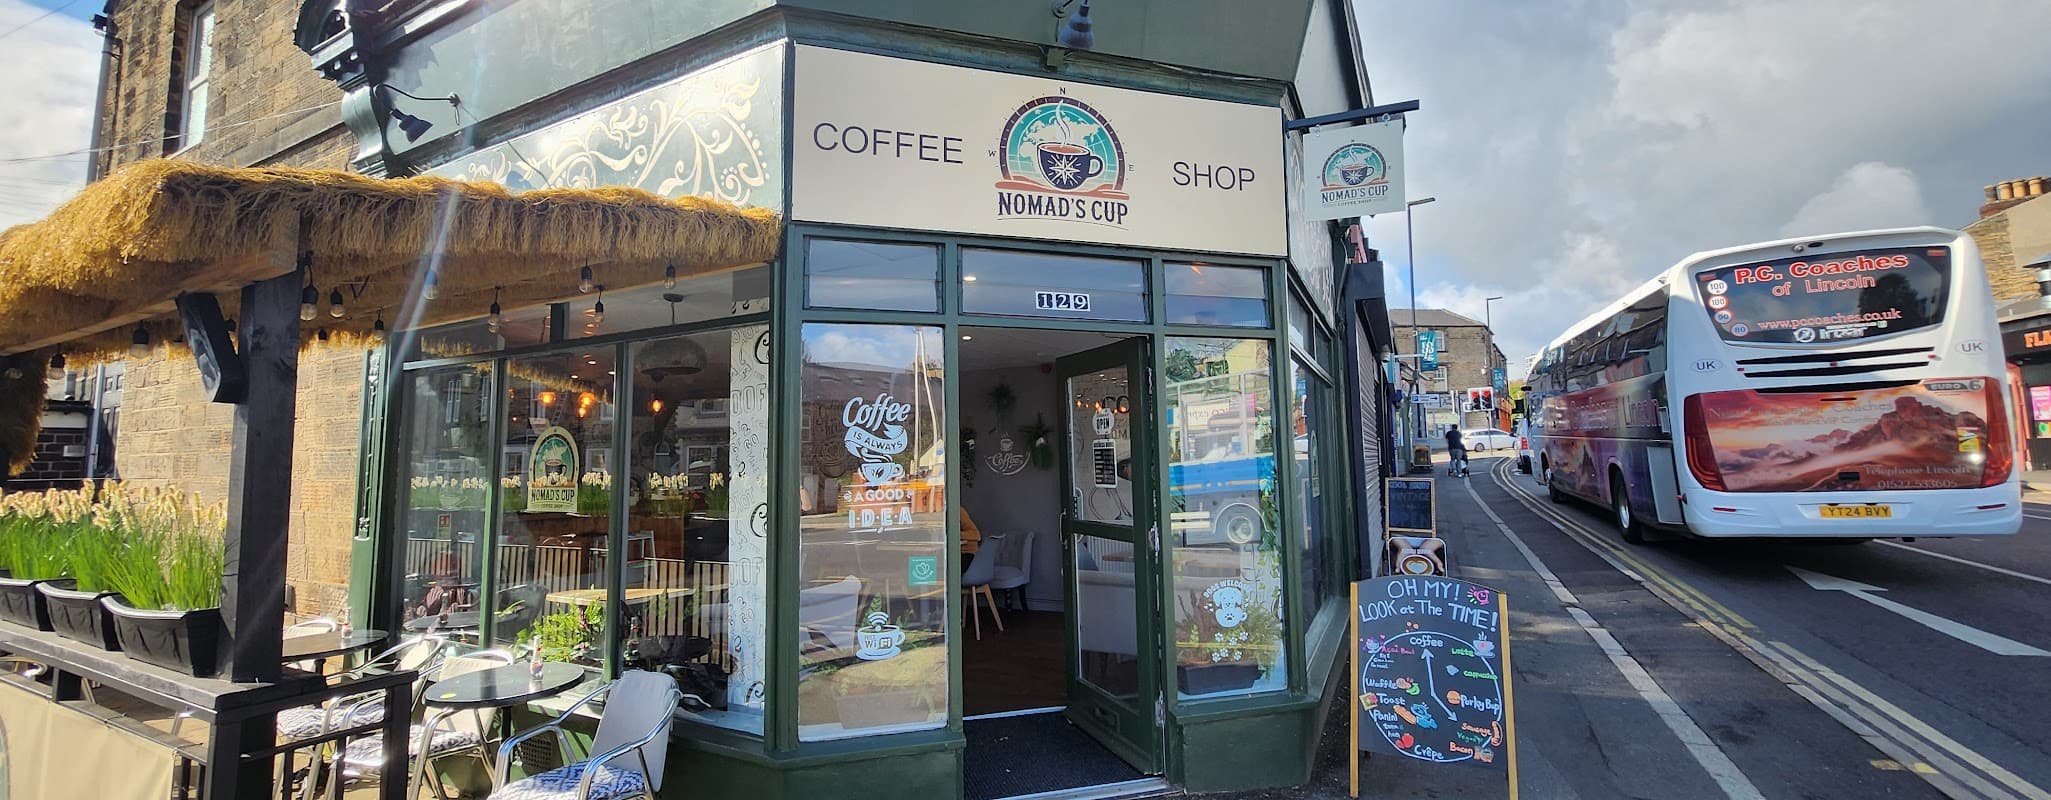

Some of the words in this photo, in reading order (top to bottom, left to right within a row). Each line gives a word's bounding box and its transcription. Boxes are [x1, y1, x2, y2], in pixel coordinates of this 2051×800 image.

[1059, 87, 1066, 95] N
[813, 122, 964, 165] COFFEE
[988, 150, 997, 158] W
[1172, 161, 1255, 192] SHOP
[1321, 187, 1366, 204] NOMAD'S
[1368, 184, 1389, 196] CUP
[998, 191, 1087, 218] NOMAD'S
[1091, 200, 1129, 224] CUP
[1734, 266, 1783, 285] P.C.
[1789, 254, 1910, 278] Coaches
[1709, 282, 1726, 291] 100
[1771, 282, 1792, 298] of
[1805, 274, 1876, 294] Lincoln
[1037, 292, 1090, 311] 129
[1711, 297, 1726, 306] 100
[1961, 342, 1983, 353] UK
[1696, 360, 1716, 371] UK
[842, 393, 912, 431] Coffee
[1096, 418, 1110, 429] OPEN
[853, 431, 863, 441] IS
[865, 437, 903, 451] ALWAYS
[531, 489, 560, 502] NOMAD'S
[561, 489, 575, 502] CUP
[854, 491, 865, 501] A
[865, 489, 905, 501] GOOD
[1828, 506, 1861, 517] YT24
[1865, 506, 1890, 516] BVY
[1203, 583, 1220, 598] DOGS
[1387, 578, 1418, 599] OH
[1359, 599, 1397, 623] LOOK
[1400, 604, 1415, 614] at
[1414, 599, 1443, 616] The
[1448, 602, 1498, 632] TIME!
[1376, 693, 1406, 706] Toast
[1460, 694, 1485, 712] Porky
[1373, 709, 1399, 722] Panini
[1414, 744, 1444, 761] Crêpe
